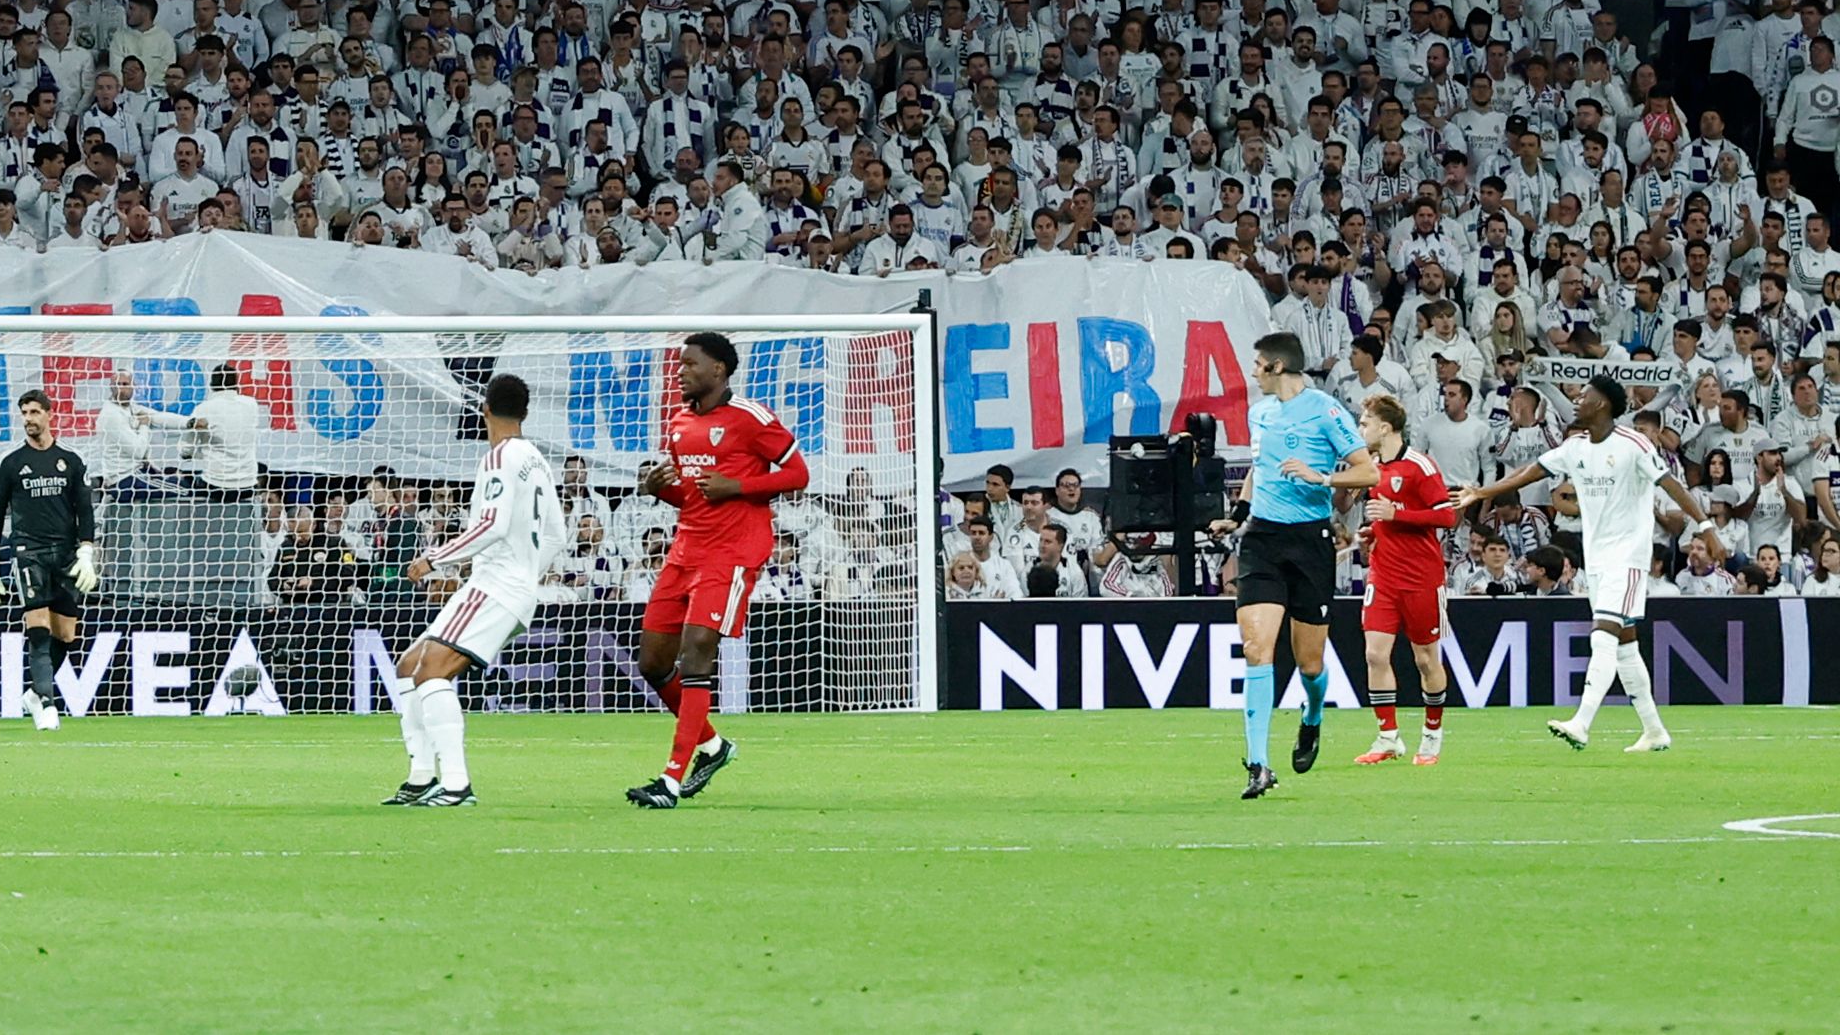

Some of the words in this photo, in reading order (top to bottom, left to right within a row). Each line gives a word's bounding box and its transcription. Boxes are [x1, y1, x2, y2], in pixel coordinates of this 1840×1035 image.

[567, 317, 1252, 455] NGREIRA
[1551, 362, 1596, 378] Real
[1603, 364, 1675, 382] Madrid
[22, 476, 68, 490] Emirates
[979, 621, 1363, 711] NIVEA
